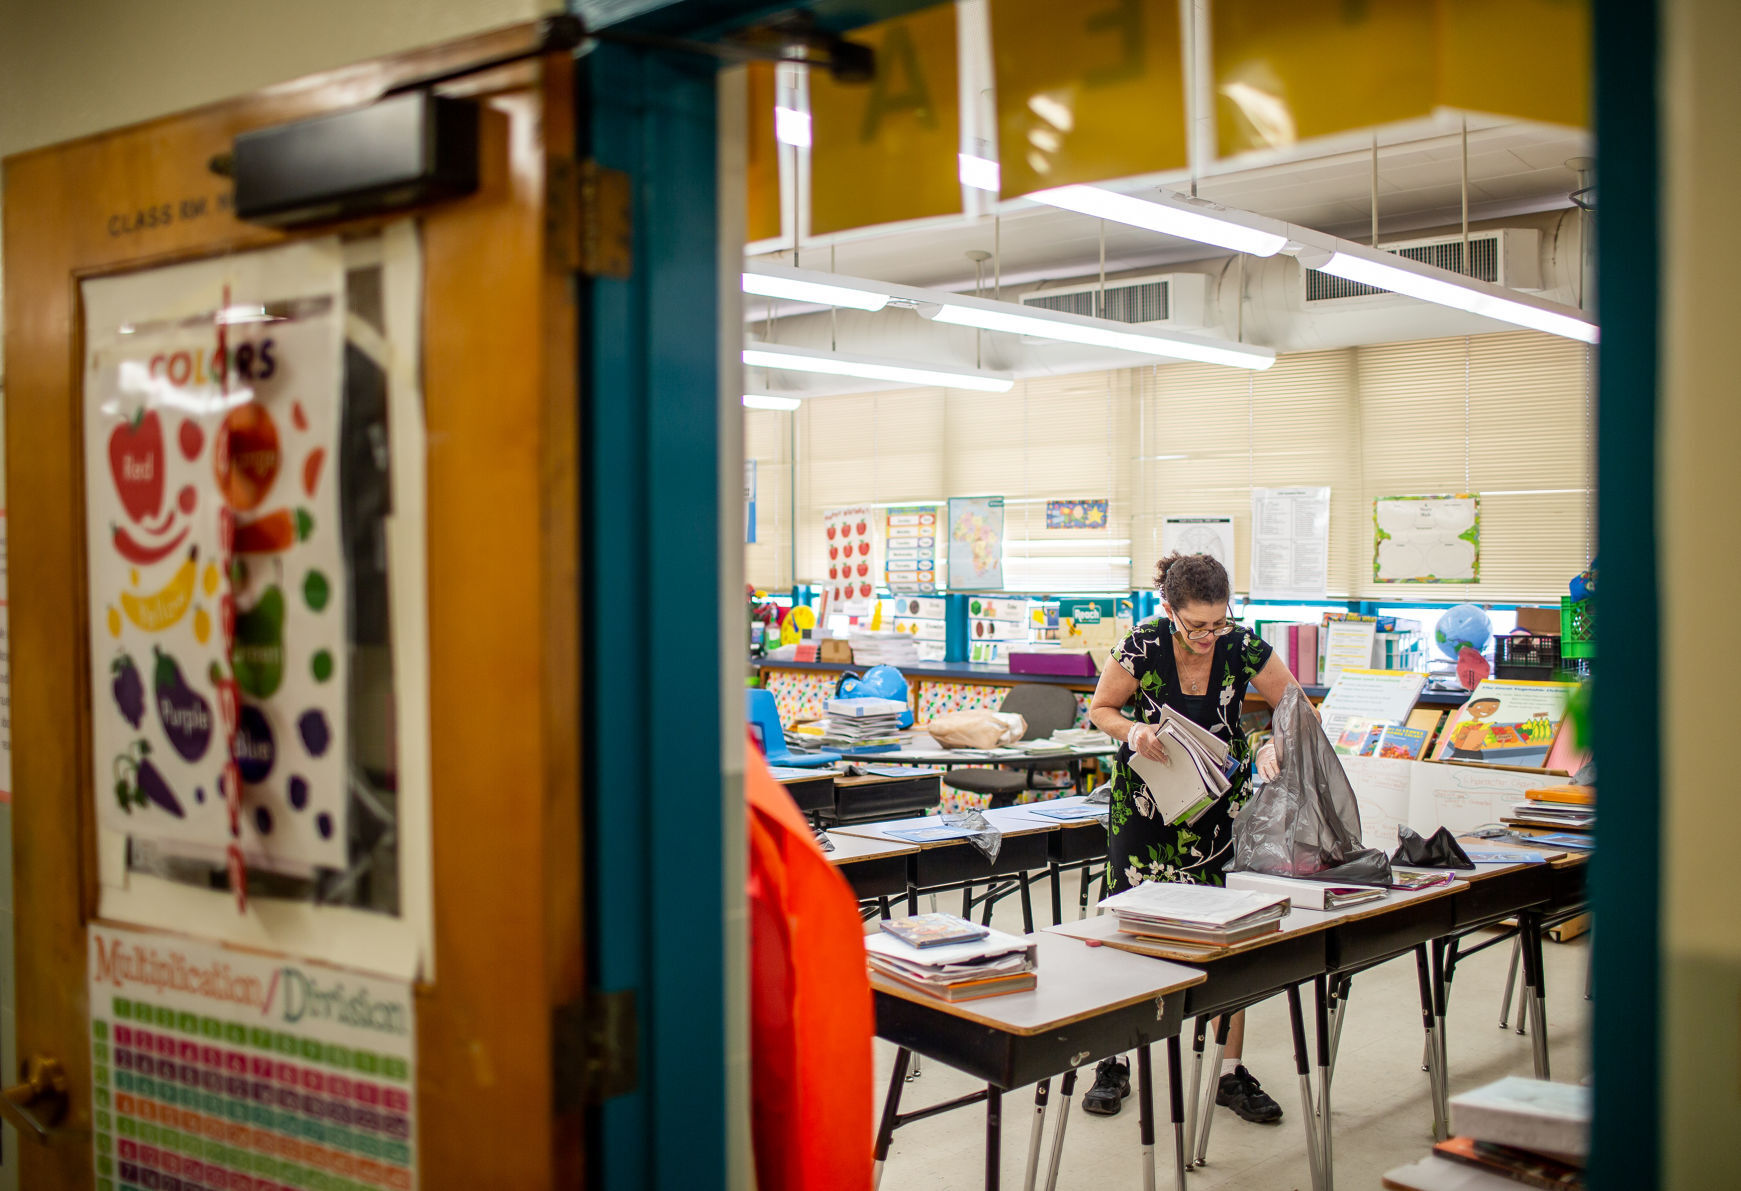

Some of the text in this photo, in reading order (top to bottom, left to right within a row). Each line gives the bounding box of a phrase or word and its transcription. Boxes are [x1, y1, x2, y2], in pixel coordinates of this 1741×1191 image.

[108, 203, 172, 236] CLASS
[122, 452, 153, 481] Red
[160, 697, 208, 737] Purple
